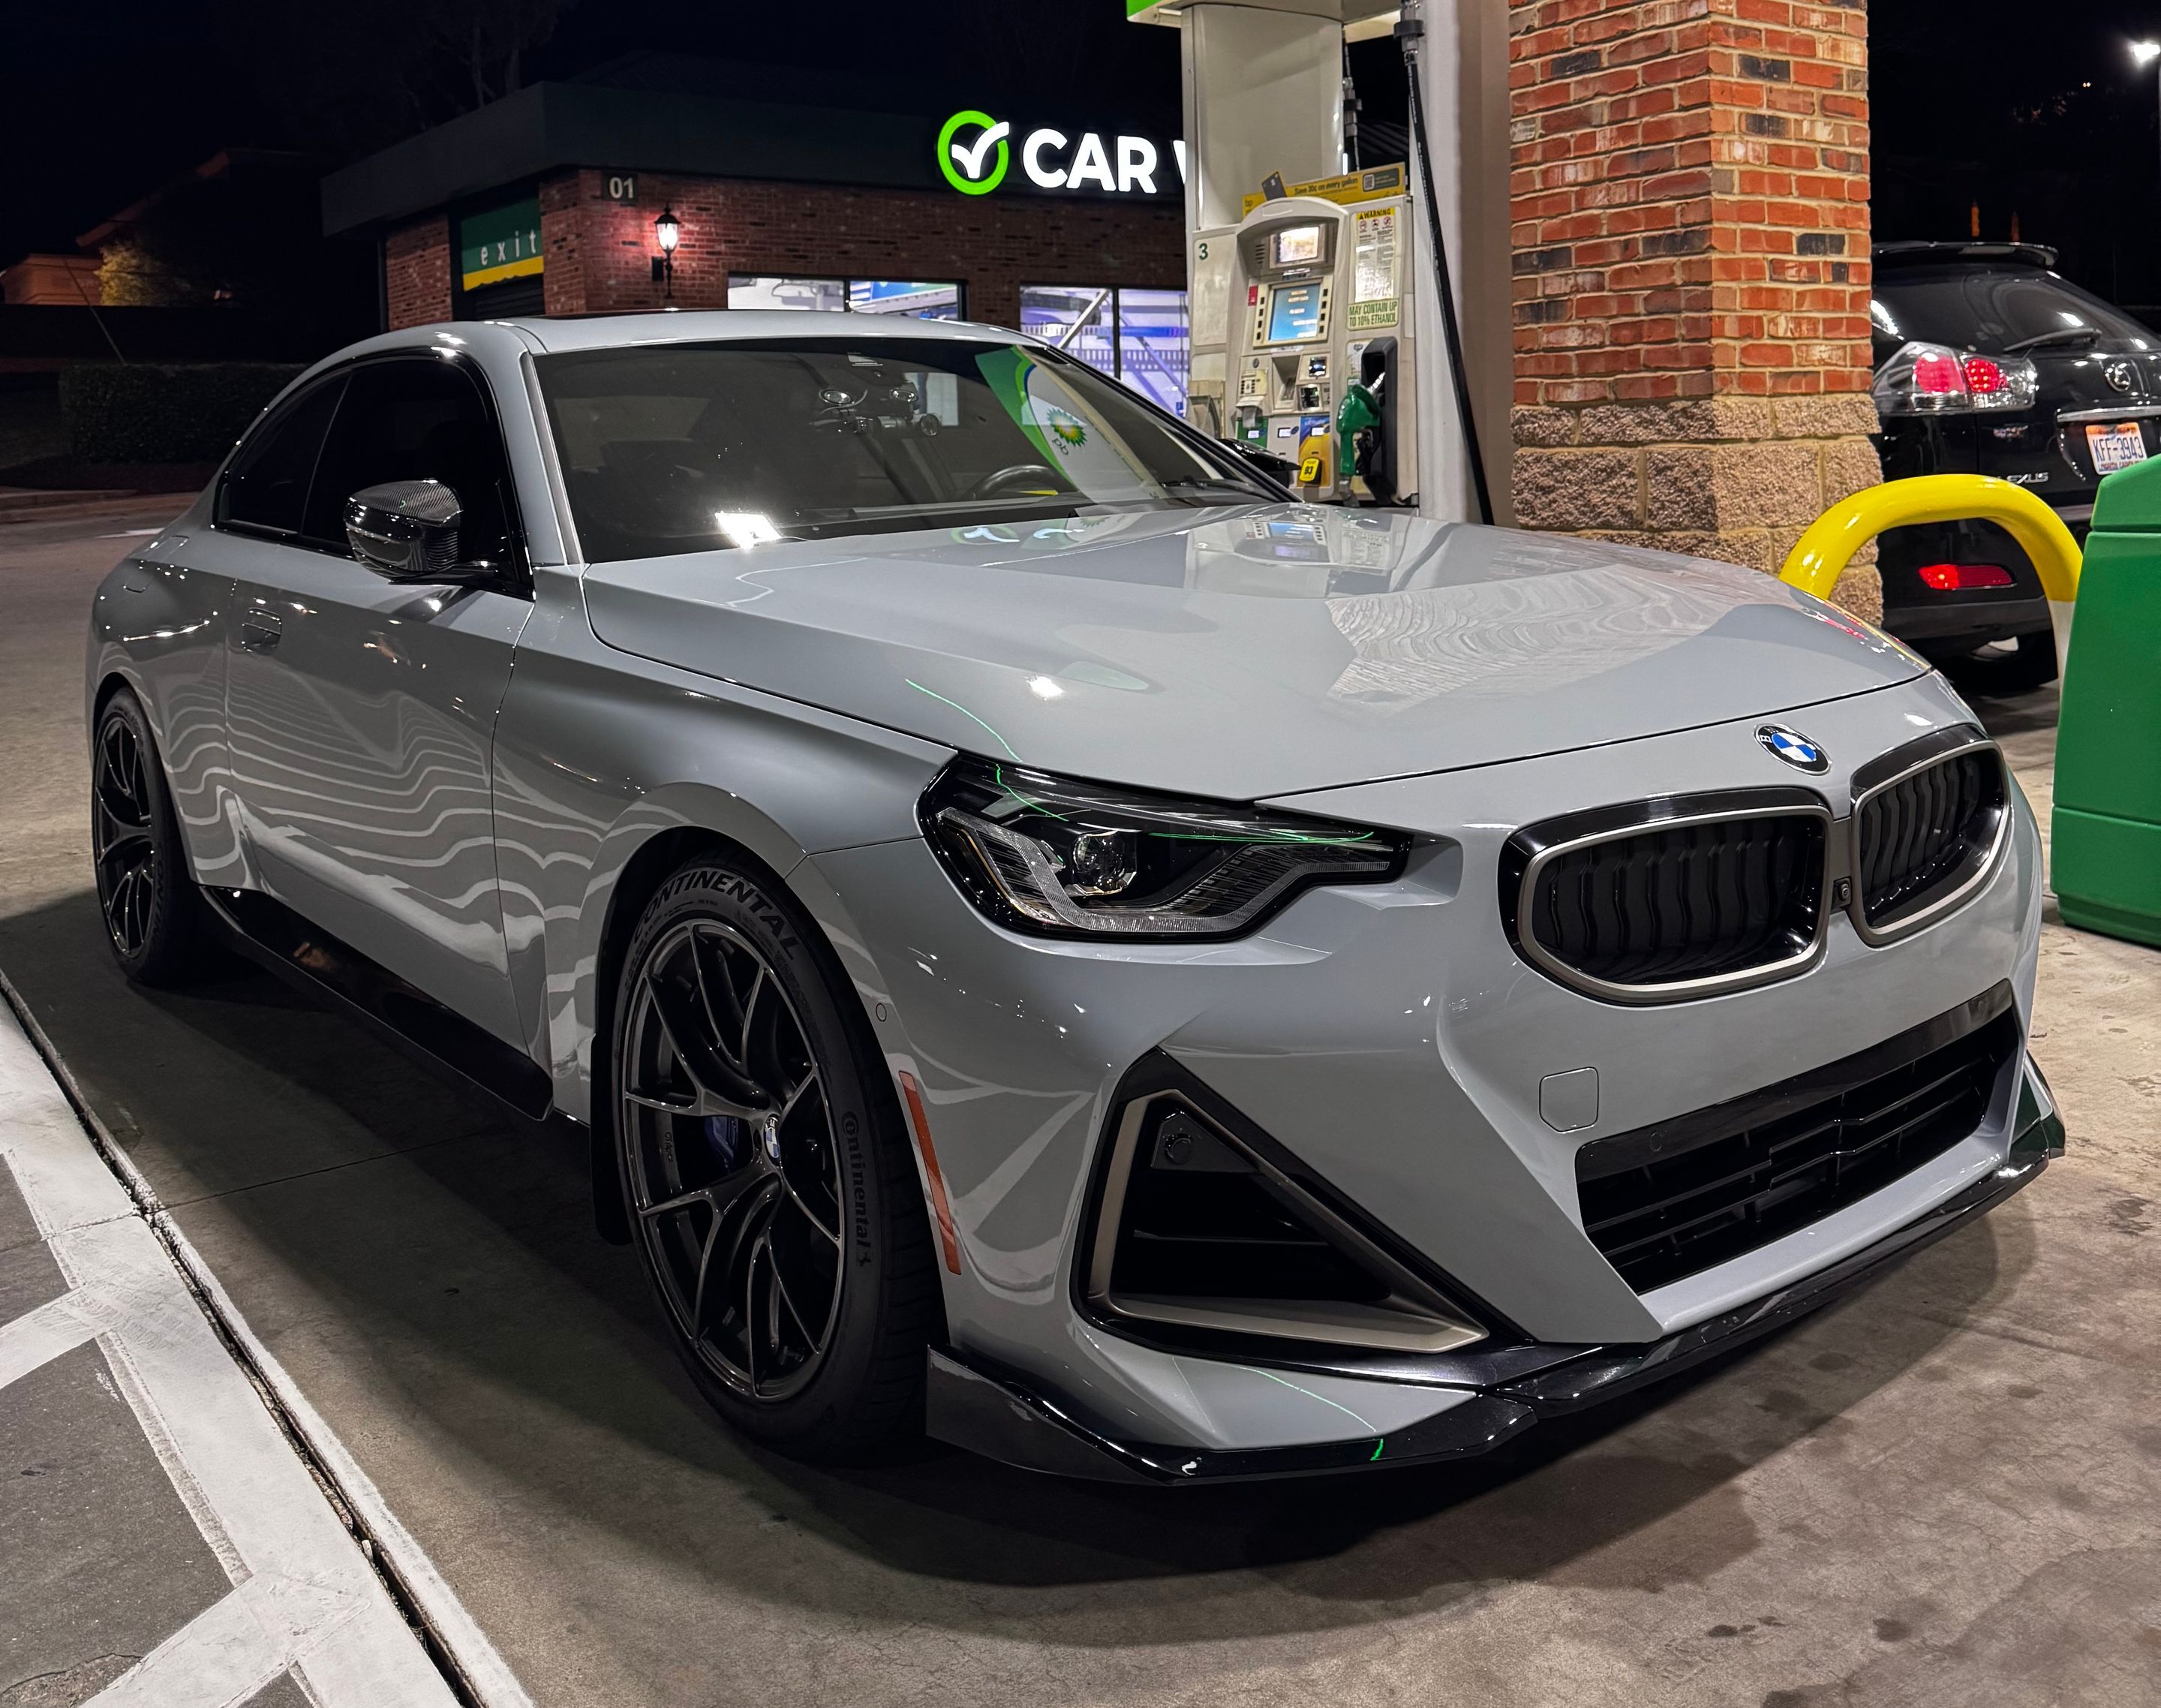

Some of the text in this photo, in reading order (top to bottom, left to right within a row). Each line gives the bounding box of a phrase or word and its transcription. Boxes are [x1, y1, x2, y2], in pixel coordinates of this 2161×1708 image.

[1023, 128, 1157, 194] CAR
[609, 177, 633, 199] 01
[1363, 209, 1391, 219] WARNING
[480, 230, 536, 266] exit
[1199, 243, 1208, 260] 3
[1349, 301, 1397, 316] MAY CONTAIN UP
[1349, 312, 1396, 326] TO 10% ETHANOL
[2093, 437, 2144, 462] KFF-3943
[1304, 465, 1314, 475] 93
[1997, 472, 2048, 484] EXUS
[634, 871, 801, 961] CONTINENTAL
